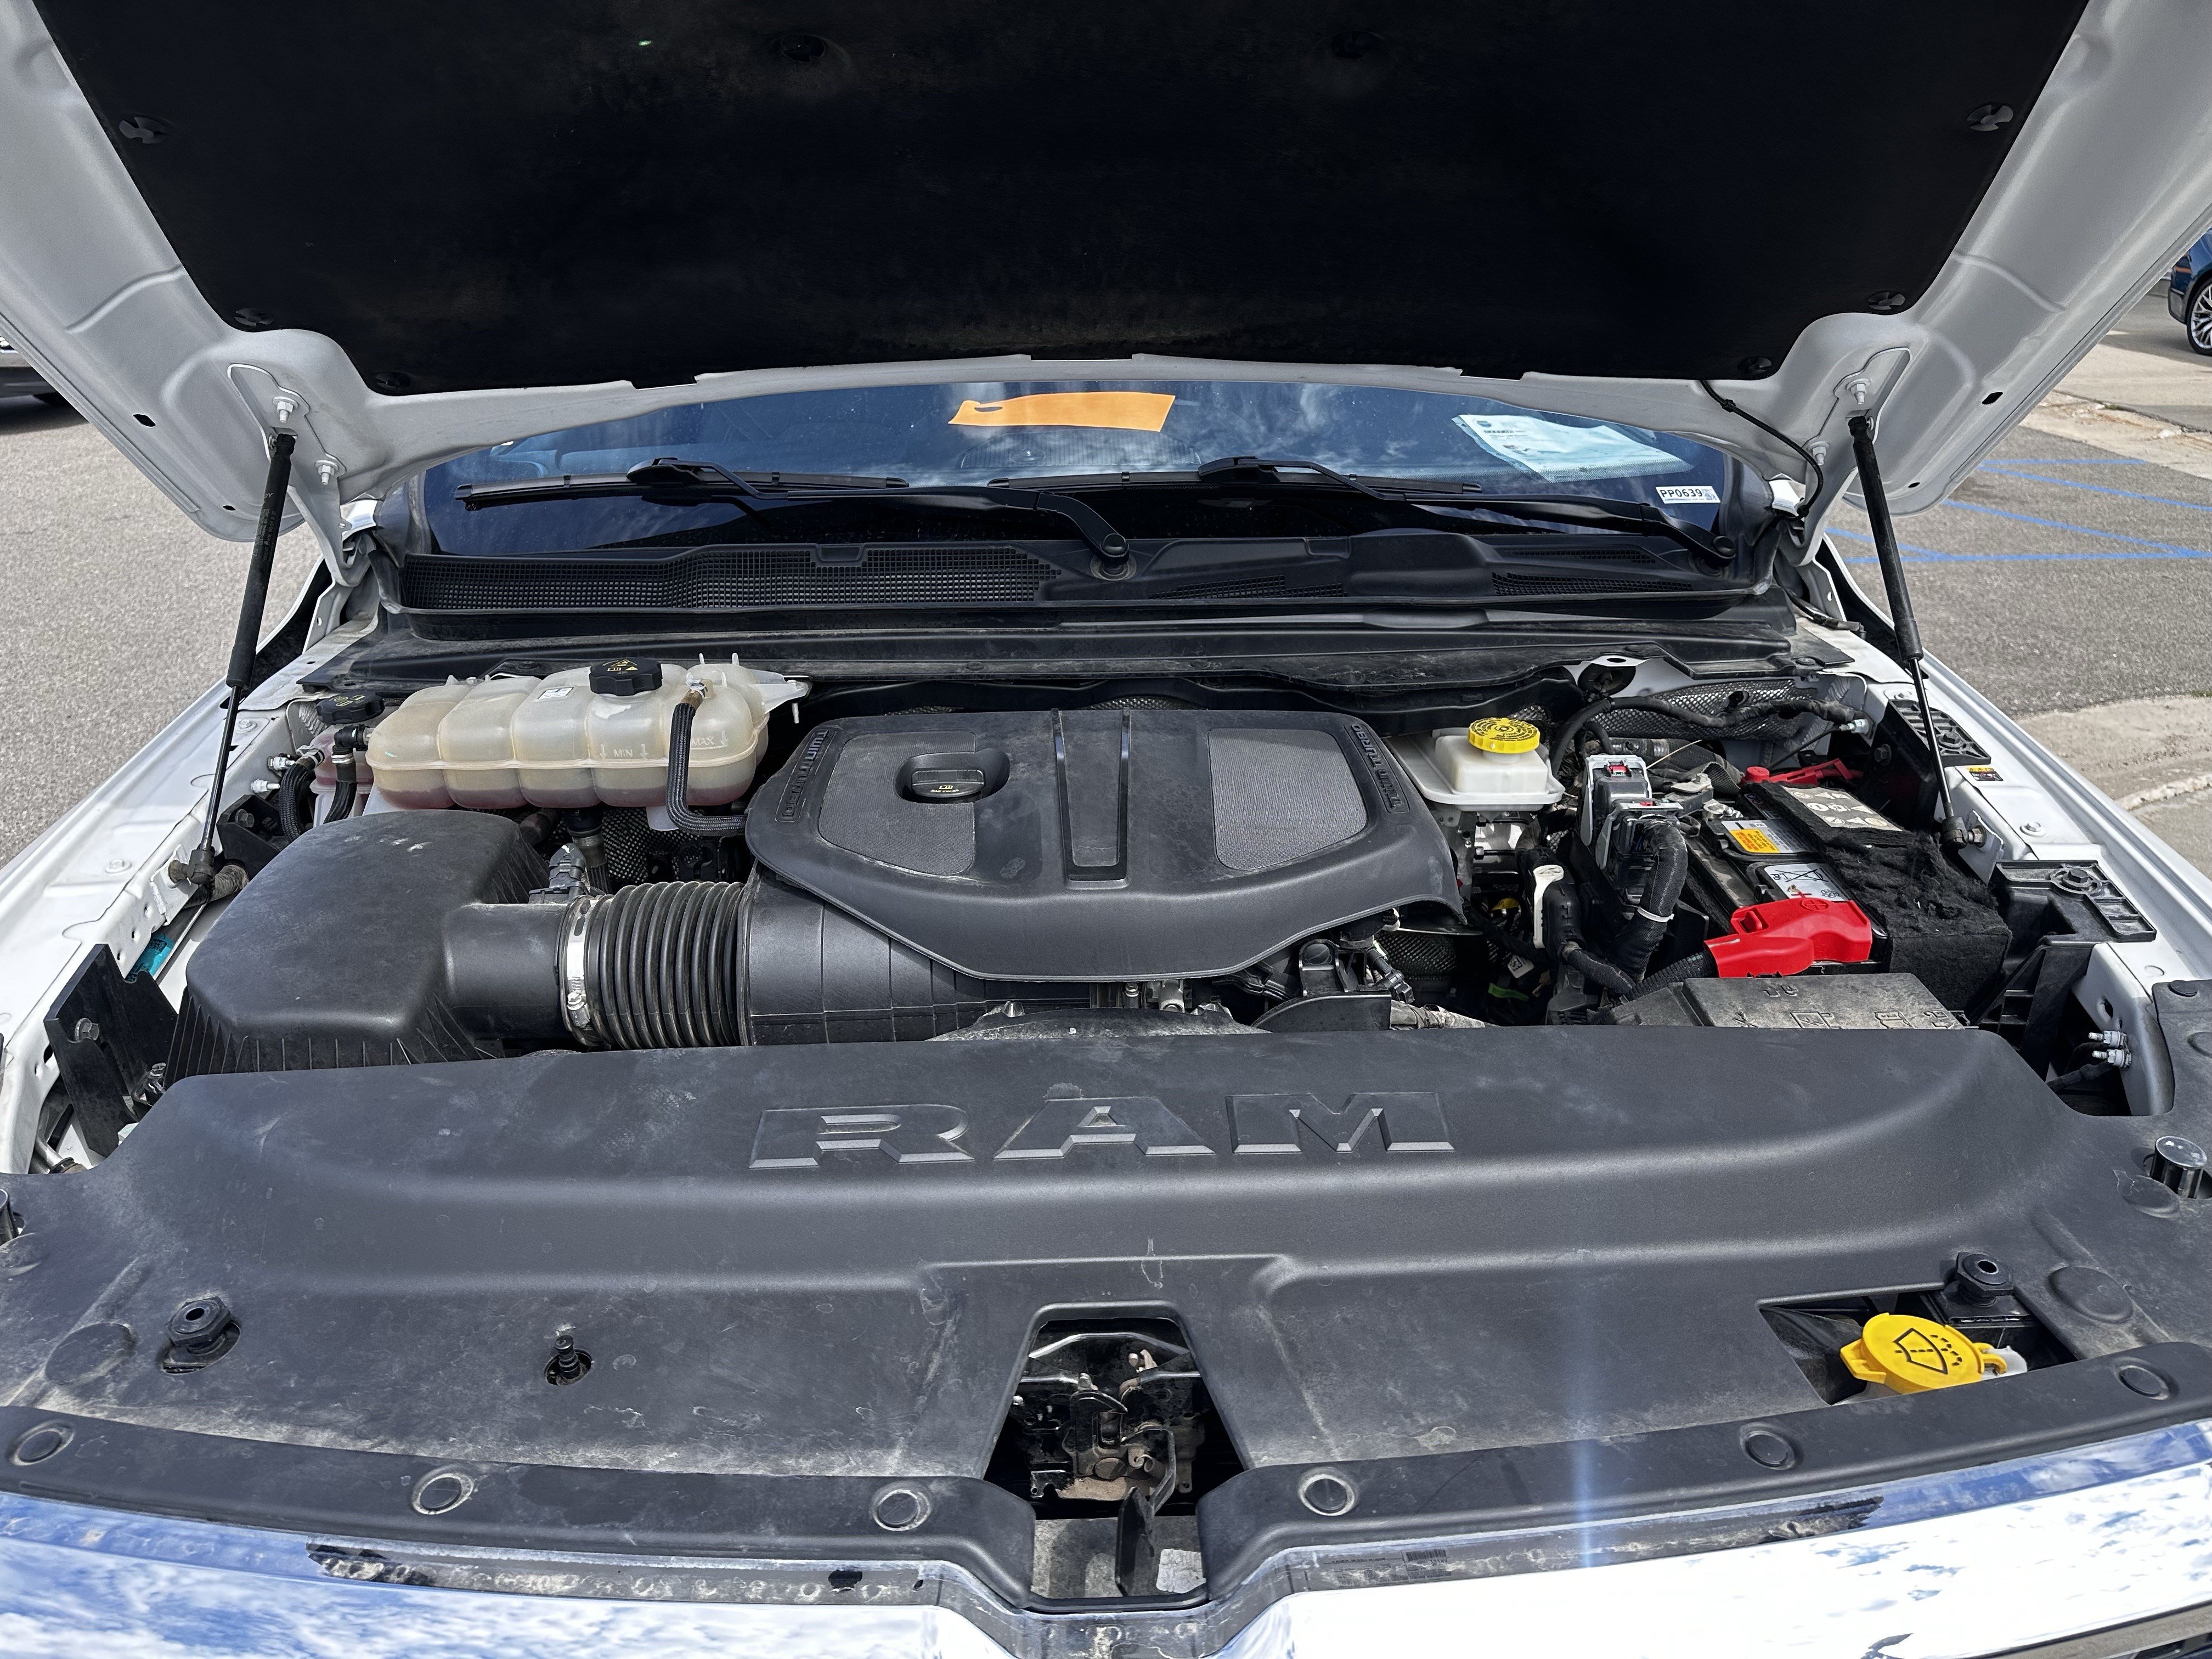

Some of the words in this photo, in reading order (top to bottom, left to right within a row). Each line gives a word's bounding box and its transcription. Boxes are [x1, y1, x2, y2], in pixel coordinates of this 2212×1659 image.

[1659, 488, 1703, 498] PP0639
[691, 737, 715, 747] MAX
[1351, 724, 1382, 768] TURBO
[613, 749, 633, 758] MIN
[748, 1091, 1457, 1170] RAM
